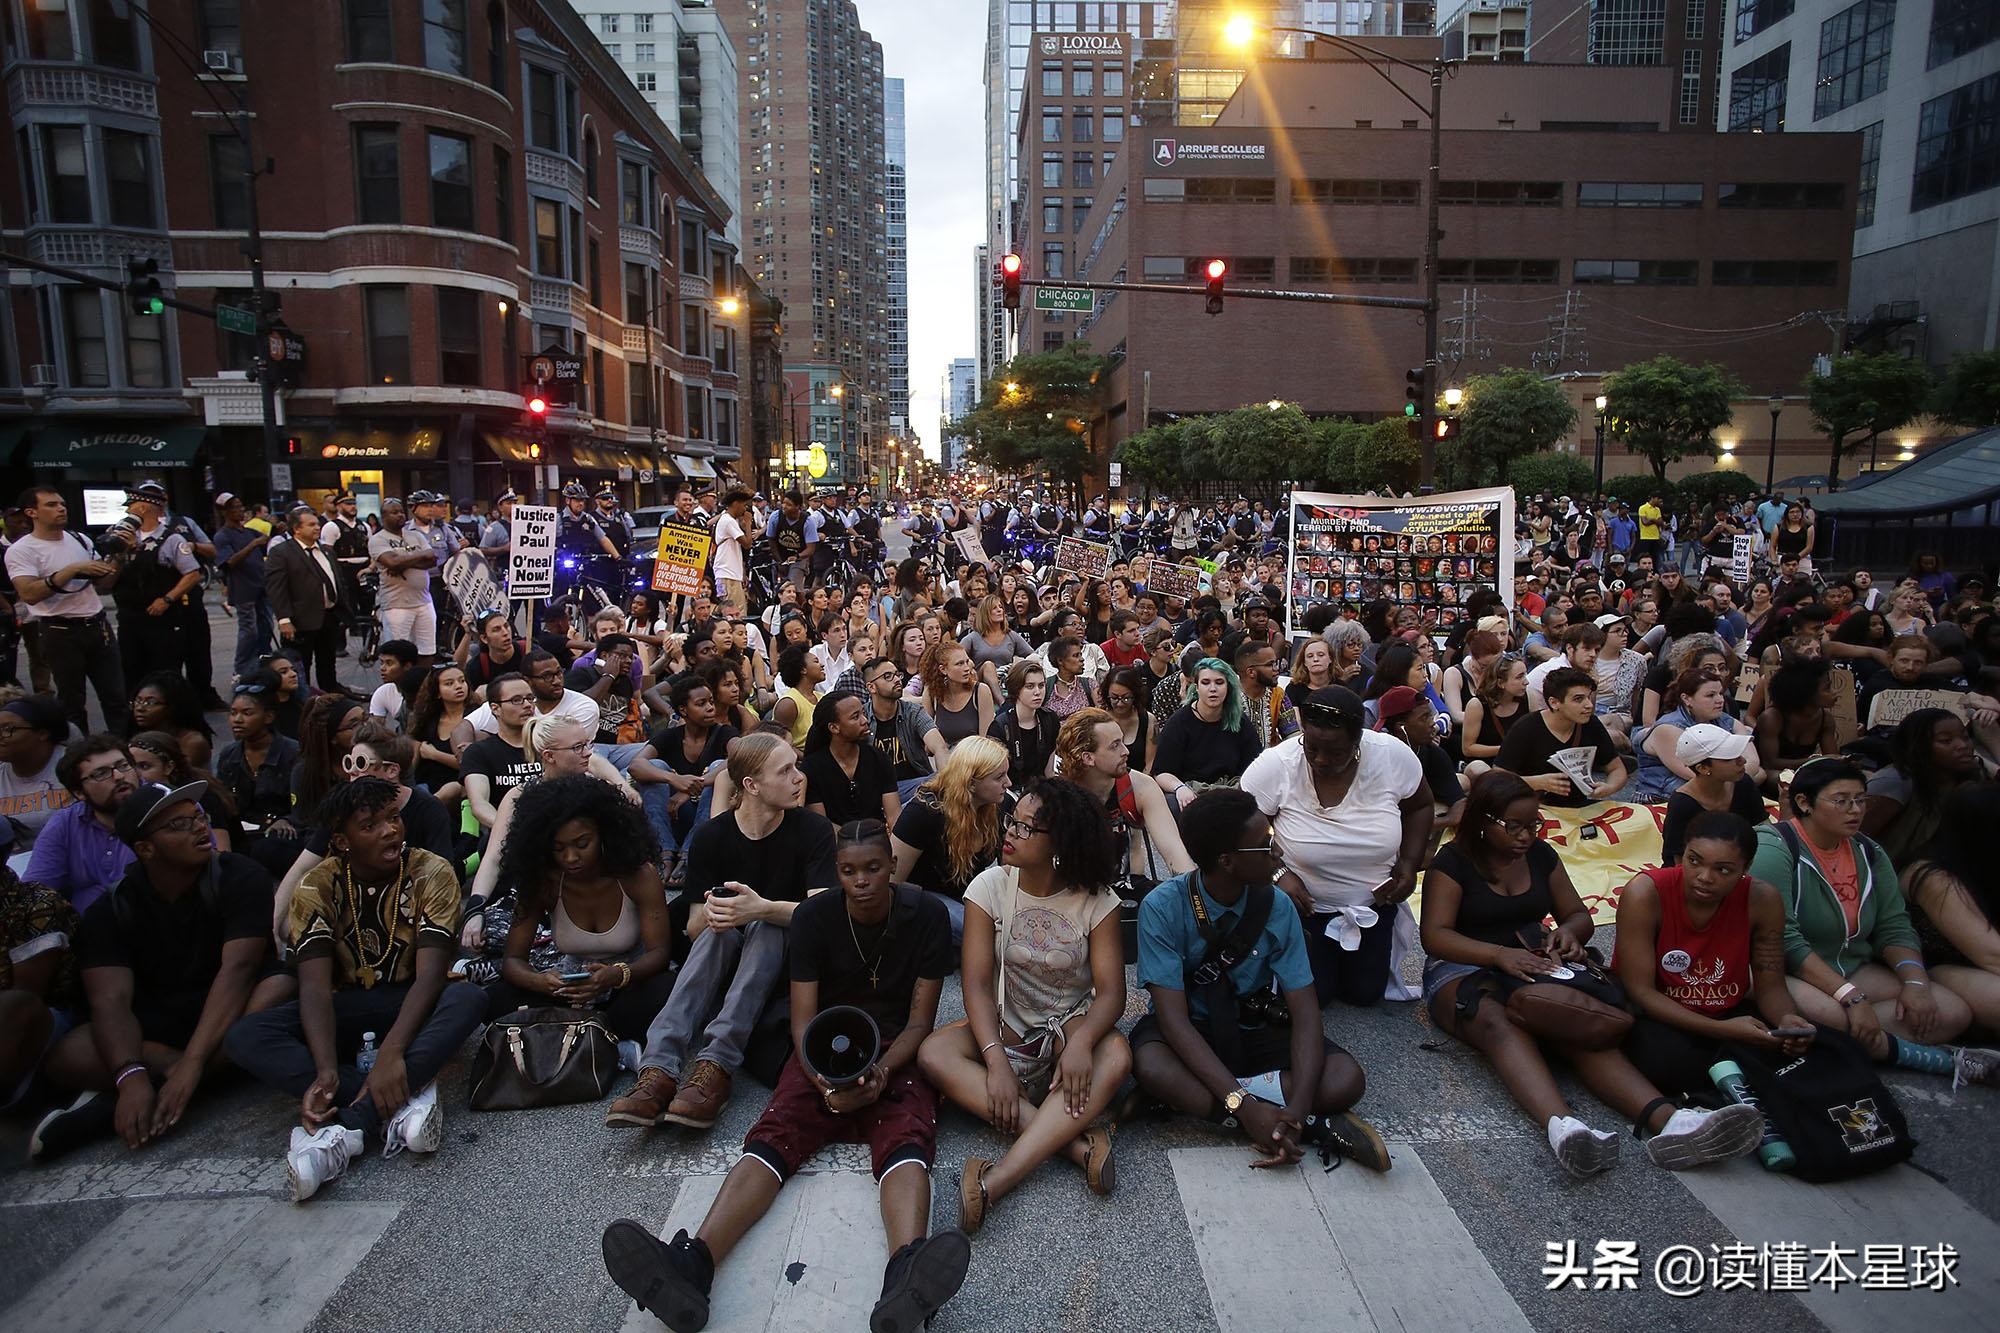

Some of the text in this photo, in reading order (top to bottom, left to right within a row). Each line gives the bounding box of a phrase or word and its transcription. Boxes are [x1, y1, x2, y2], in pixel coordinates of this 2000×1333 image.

[1063, 36, 1122, 49] LOYOLA
[1178, 145, 1265, 154] ARRUPE COLLEGE
[1039, 290, 1080, 301] CHICAGO
[555, 360, 580, 371] Byline
[556, 370, 577, 378] Bank
[68, 433, 168, 452] ALFREDO'S
[338, 447, 365, 458] Byline
[365, 447, 390, 457] Bank
[1311, 506, 1370, 520] STOP
[1394, 502, 1499, 514] www.revcom.us
[515, 508, 555, 522] Justice
[1310, 517, 1370, 526] MURDER AND
[527, 522, 545, 535] for
[1297, 524, 1383, 533] TERROR BY POLICE
[1402, 525, 1491, 534] ACTUAL revolution
[1408, 519, 1454, 528] organized
[520, 535, 550, 548] Paul
[669, 530, 704, 543] America
[676, 538, 693, 548] Was
[1735, 536, 1750, 545] Stop
[665, 543, 701, 560] NEVER
[513, 555, 552, 568] O'neal
[668, 554, 695, 566] Great!
[516, 569, 549, 582] Now!
[657, 561, 698, 577] We Need To
[656, 570, 700, 586] OVERTHROW
[655, 578, 699, 594] This System!
[1882, 690, 1933, 700] UNITED
[507, 761, 542, 774] I NEED
[495, 775, 521, 786] MORE
[1193, 894, 1206, 920] Nikon
[1665, 982, 1739, 999] MONACO
[1775, 1056, 1806, 1076] ZOU
[1849, 1136, 1896, 1154] MISSOURI
